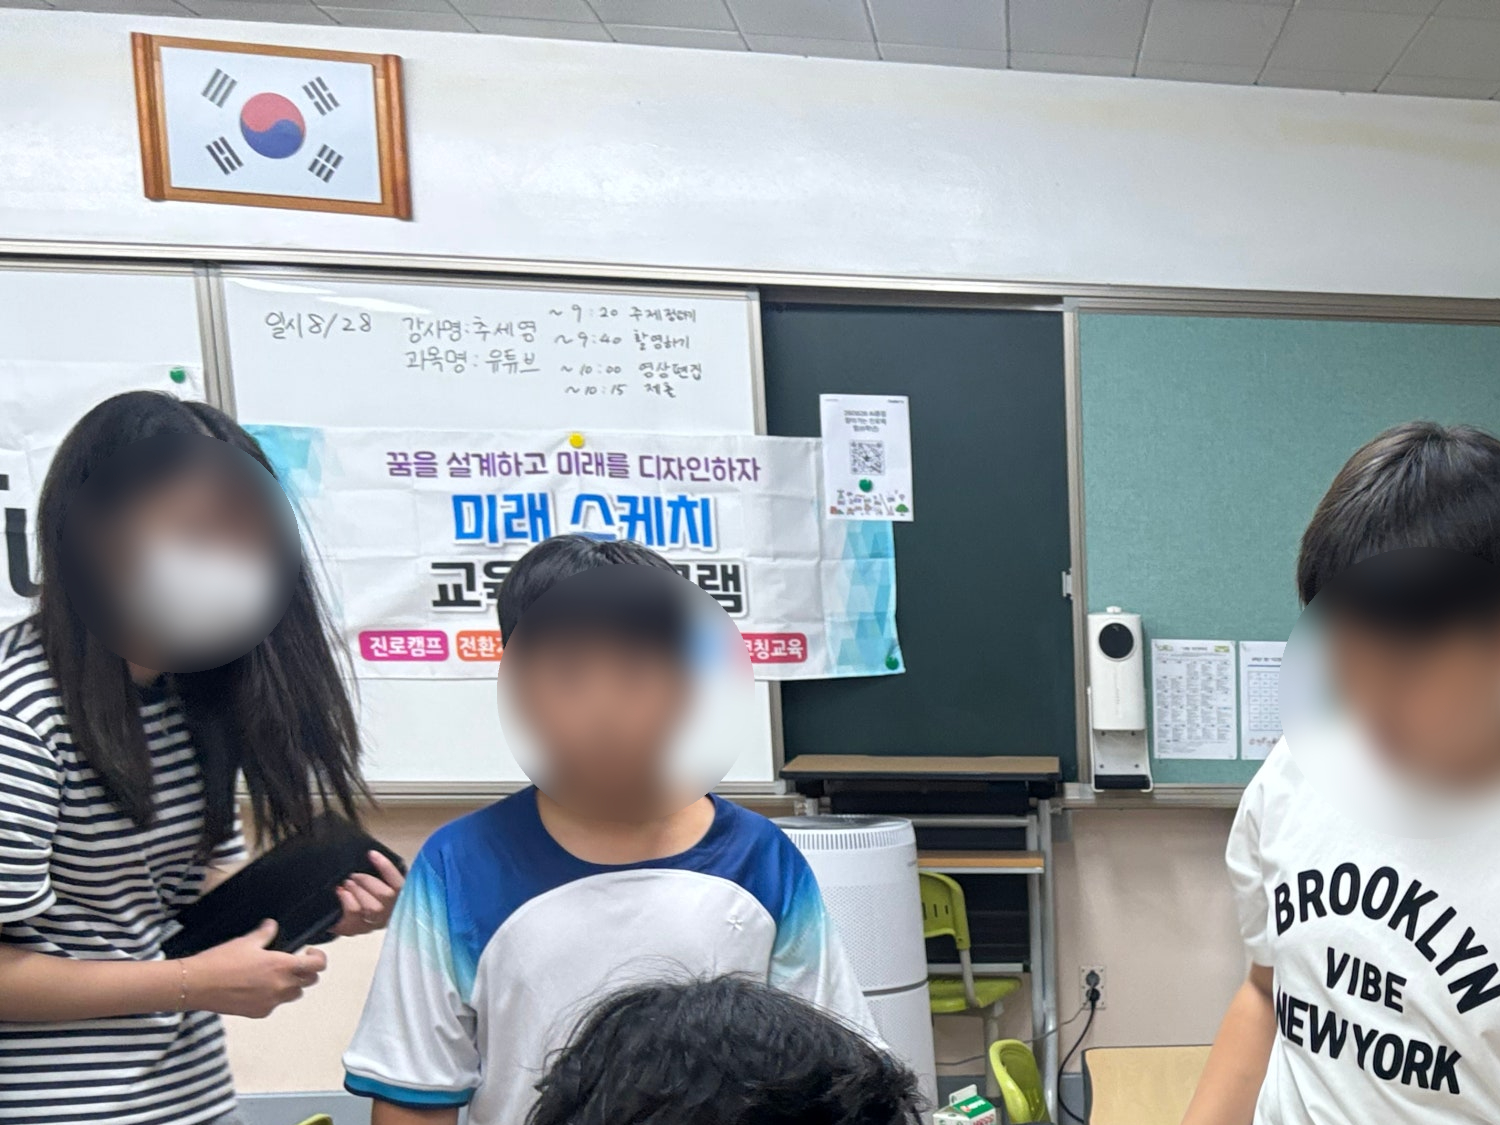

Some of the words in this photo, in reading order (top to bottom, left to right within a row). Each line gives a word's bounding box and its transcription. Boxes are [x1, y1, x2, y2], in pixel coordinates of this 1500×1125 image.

[386, 451, 438, 478] 꿈을
[446, 451, 550, 478] 설계하고
[558, 452, 630, 480] 미래를
[639, 453, 761, 482] 디자인하자
[452, 493, 551, 544] 미래
[369, 636, 444, 658] 진로캠프
[459, 636, 504, 658] 전환
[1326, 946, 1407, 1014] VIBE
[1276, 986, 1349, 1060] NEW
[1353, 1023, 1462, 1095] YORK
